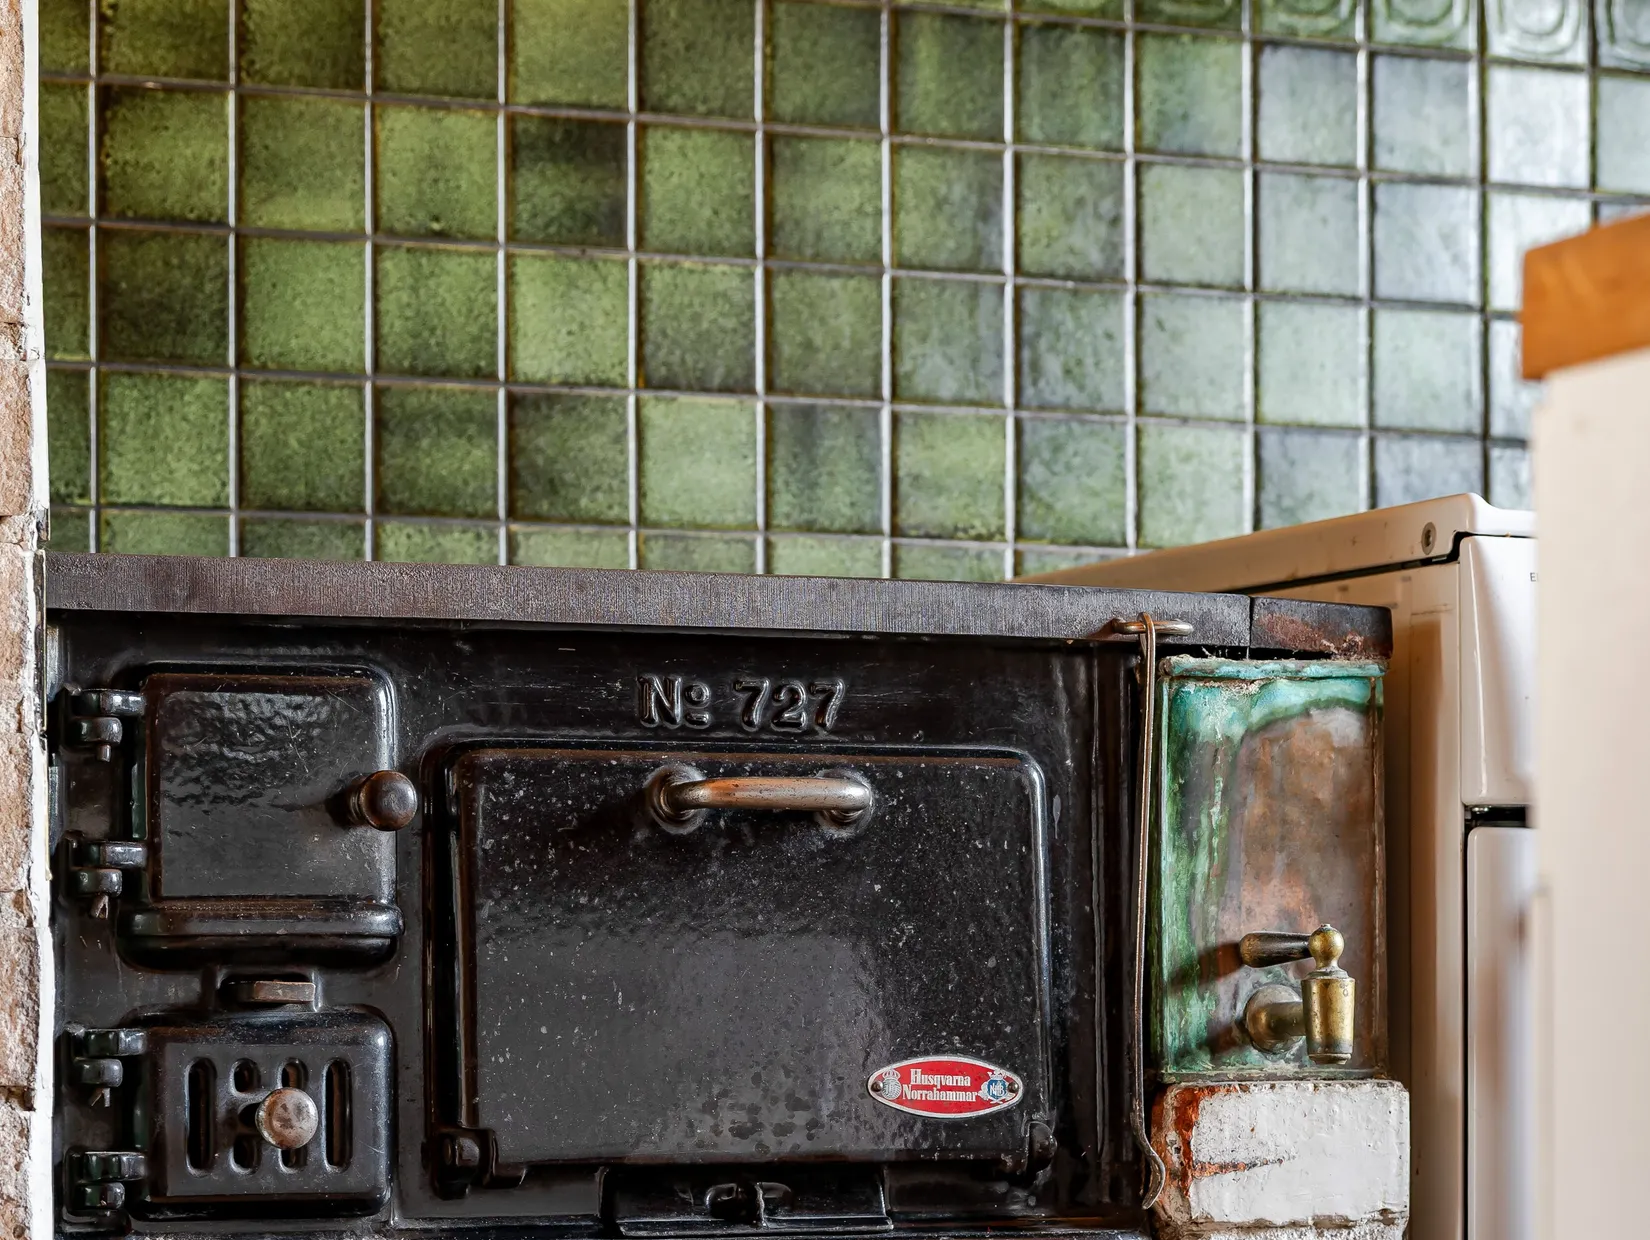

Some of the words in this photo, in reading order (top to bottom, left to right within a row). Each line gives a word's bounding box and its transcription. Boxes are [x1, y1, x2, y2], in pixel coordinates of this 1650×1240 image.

[733, 677, 846, 732] 727
[910, 1068, 971, 1088] Husqvarna
[902, 1084, 979, 1102] Norrahammar
